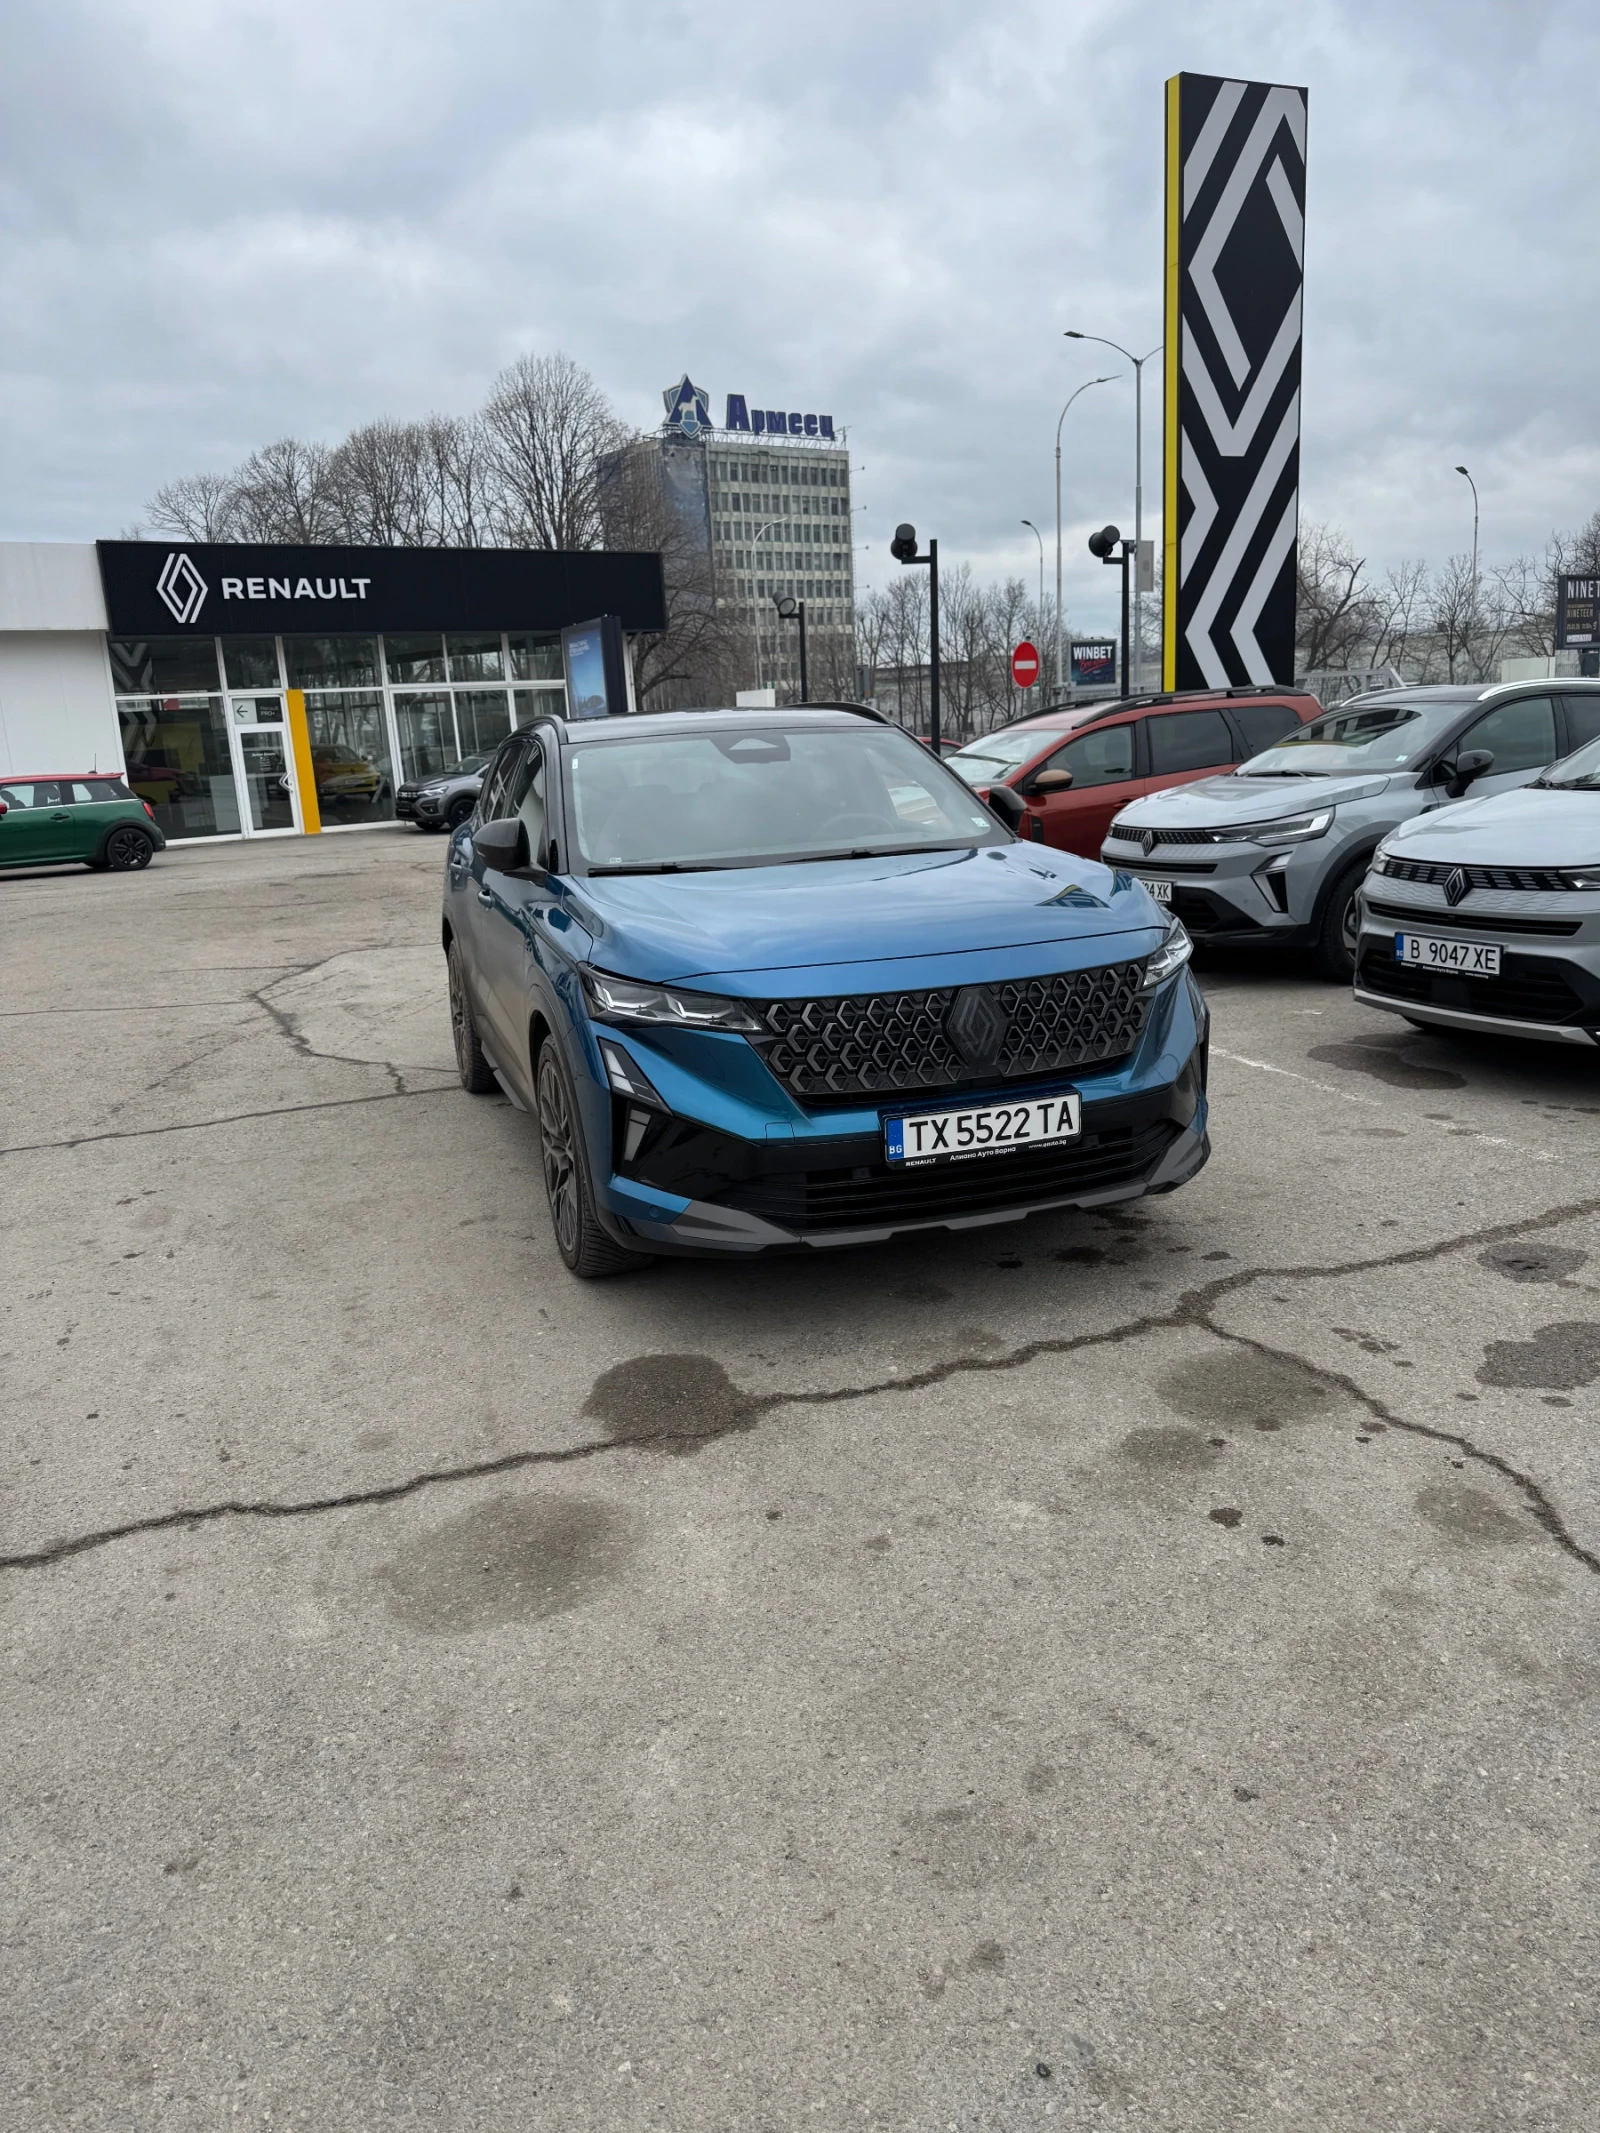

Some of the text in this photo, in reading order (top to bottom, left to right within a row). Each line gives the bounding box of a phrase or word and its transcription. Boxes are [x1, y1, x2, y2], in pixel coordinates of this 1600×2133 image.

[726, 394, 836, 441] Армеец
[221, 577, 371, 600] RENAULT
[1073, 646, 1112, 660] WINBET
[1157, 883, 1169, 899] XK
[1411, 939, 1420, 959] B
[1429, 942, 1469, 965] 9047
[1473, 947, 1496, 971] XE
[909, 1100, 1074, 1152] TX 5522 TA
[889, 1144, 903, 1155] BG
[905, 1157, 937, 1167] RENAULT
